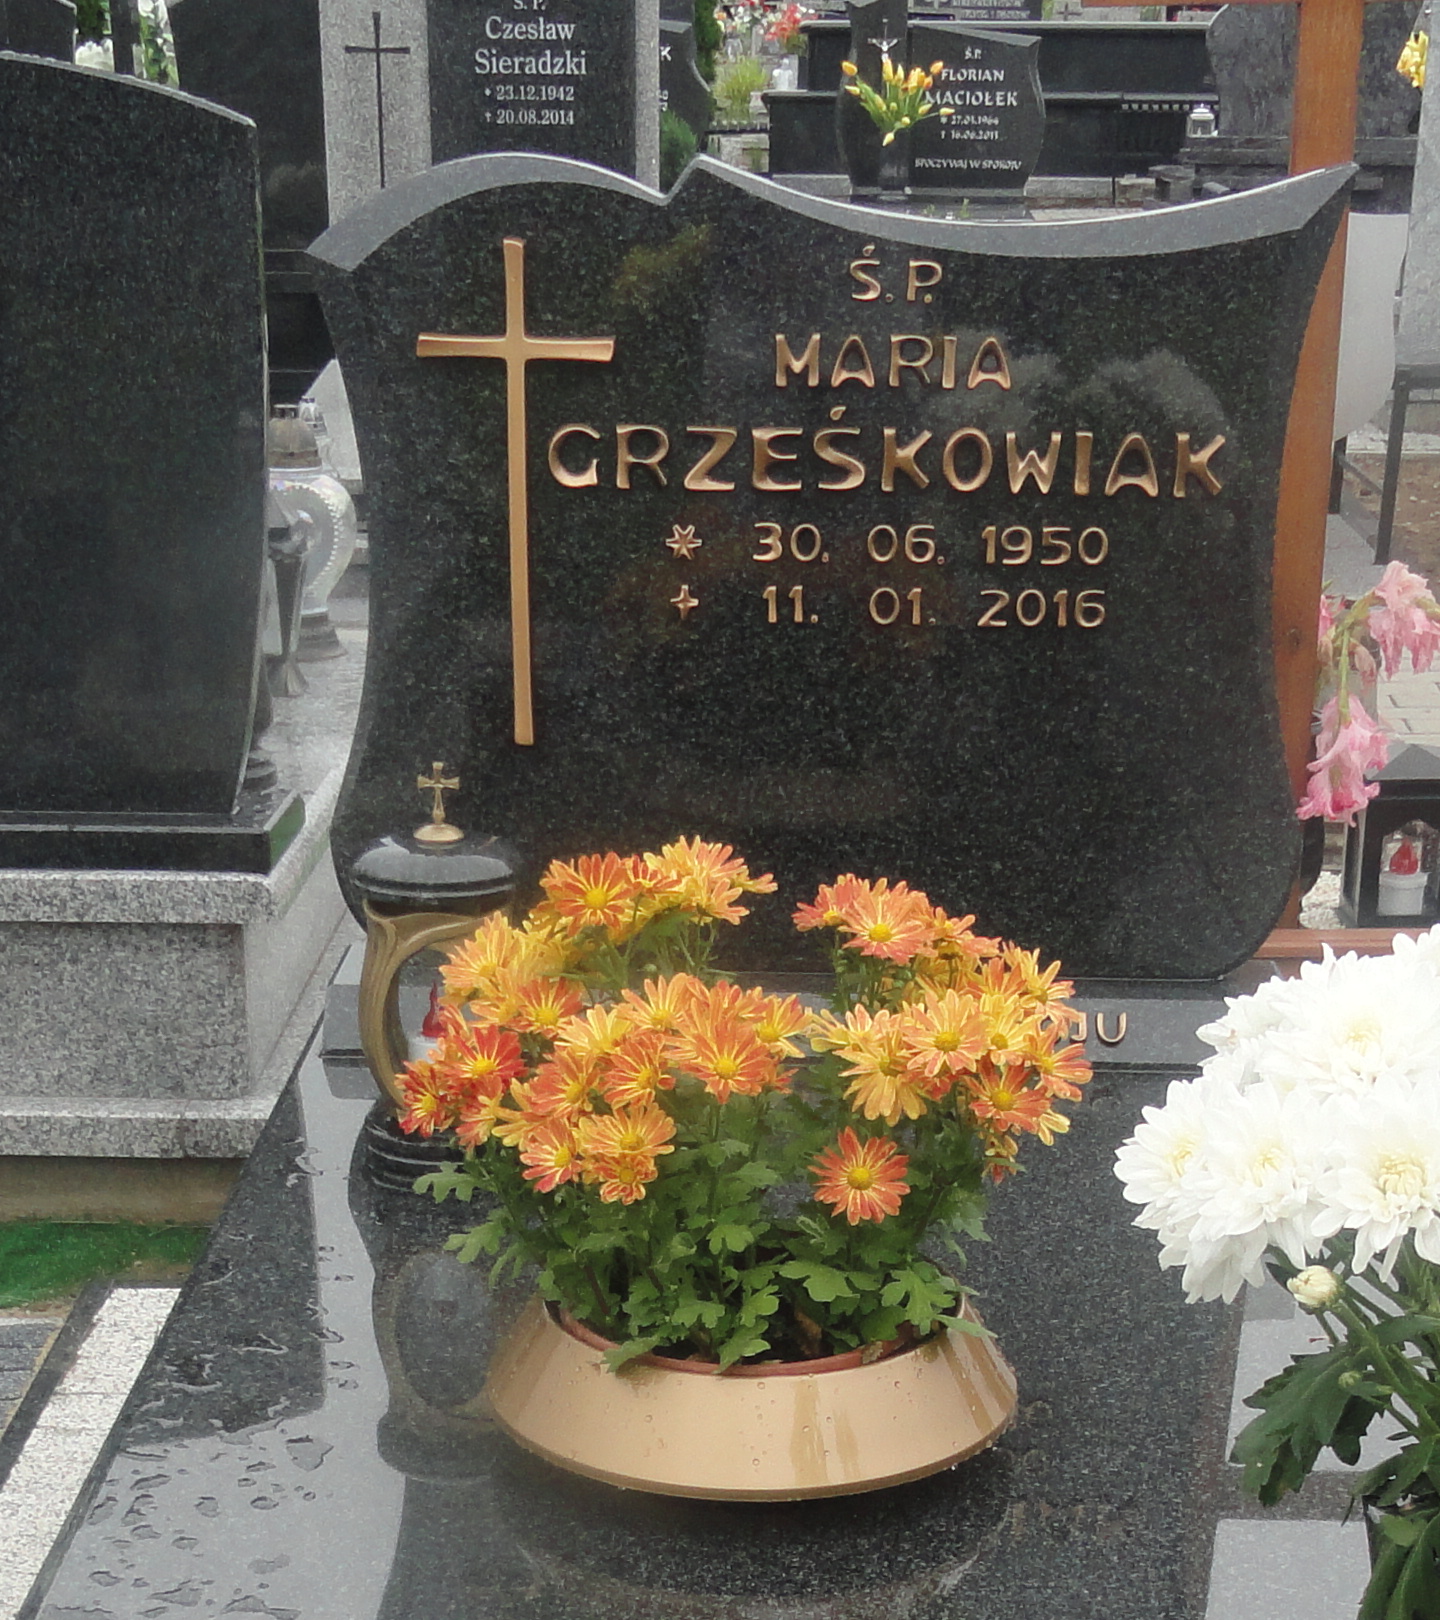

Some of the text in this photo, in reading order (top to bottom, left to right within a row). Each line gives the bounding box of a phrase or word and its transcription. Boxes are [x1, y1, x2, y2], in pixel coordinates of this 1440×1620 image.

[485, 16, 576, 40] Czesław
[474, 48, 587, 75] Sieradzki
[941, 68, 1004, 82] FLORIAN
[496, 85, 574, 101] 23.12.1942
[924, 90, 1018, 107] MACIOŁEK
[496, 109, 574, 125] 20.08.2014
[774, 333, 1011, 390] MARIA
[548, 405, 1226, 498] GRZEŚKOWIAK
[752, 523, 1109, 566] 30. 06. 1950
[762, 585, 1106, 628] 11. 01. 2016
